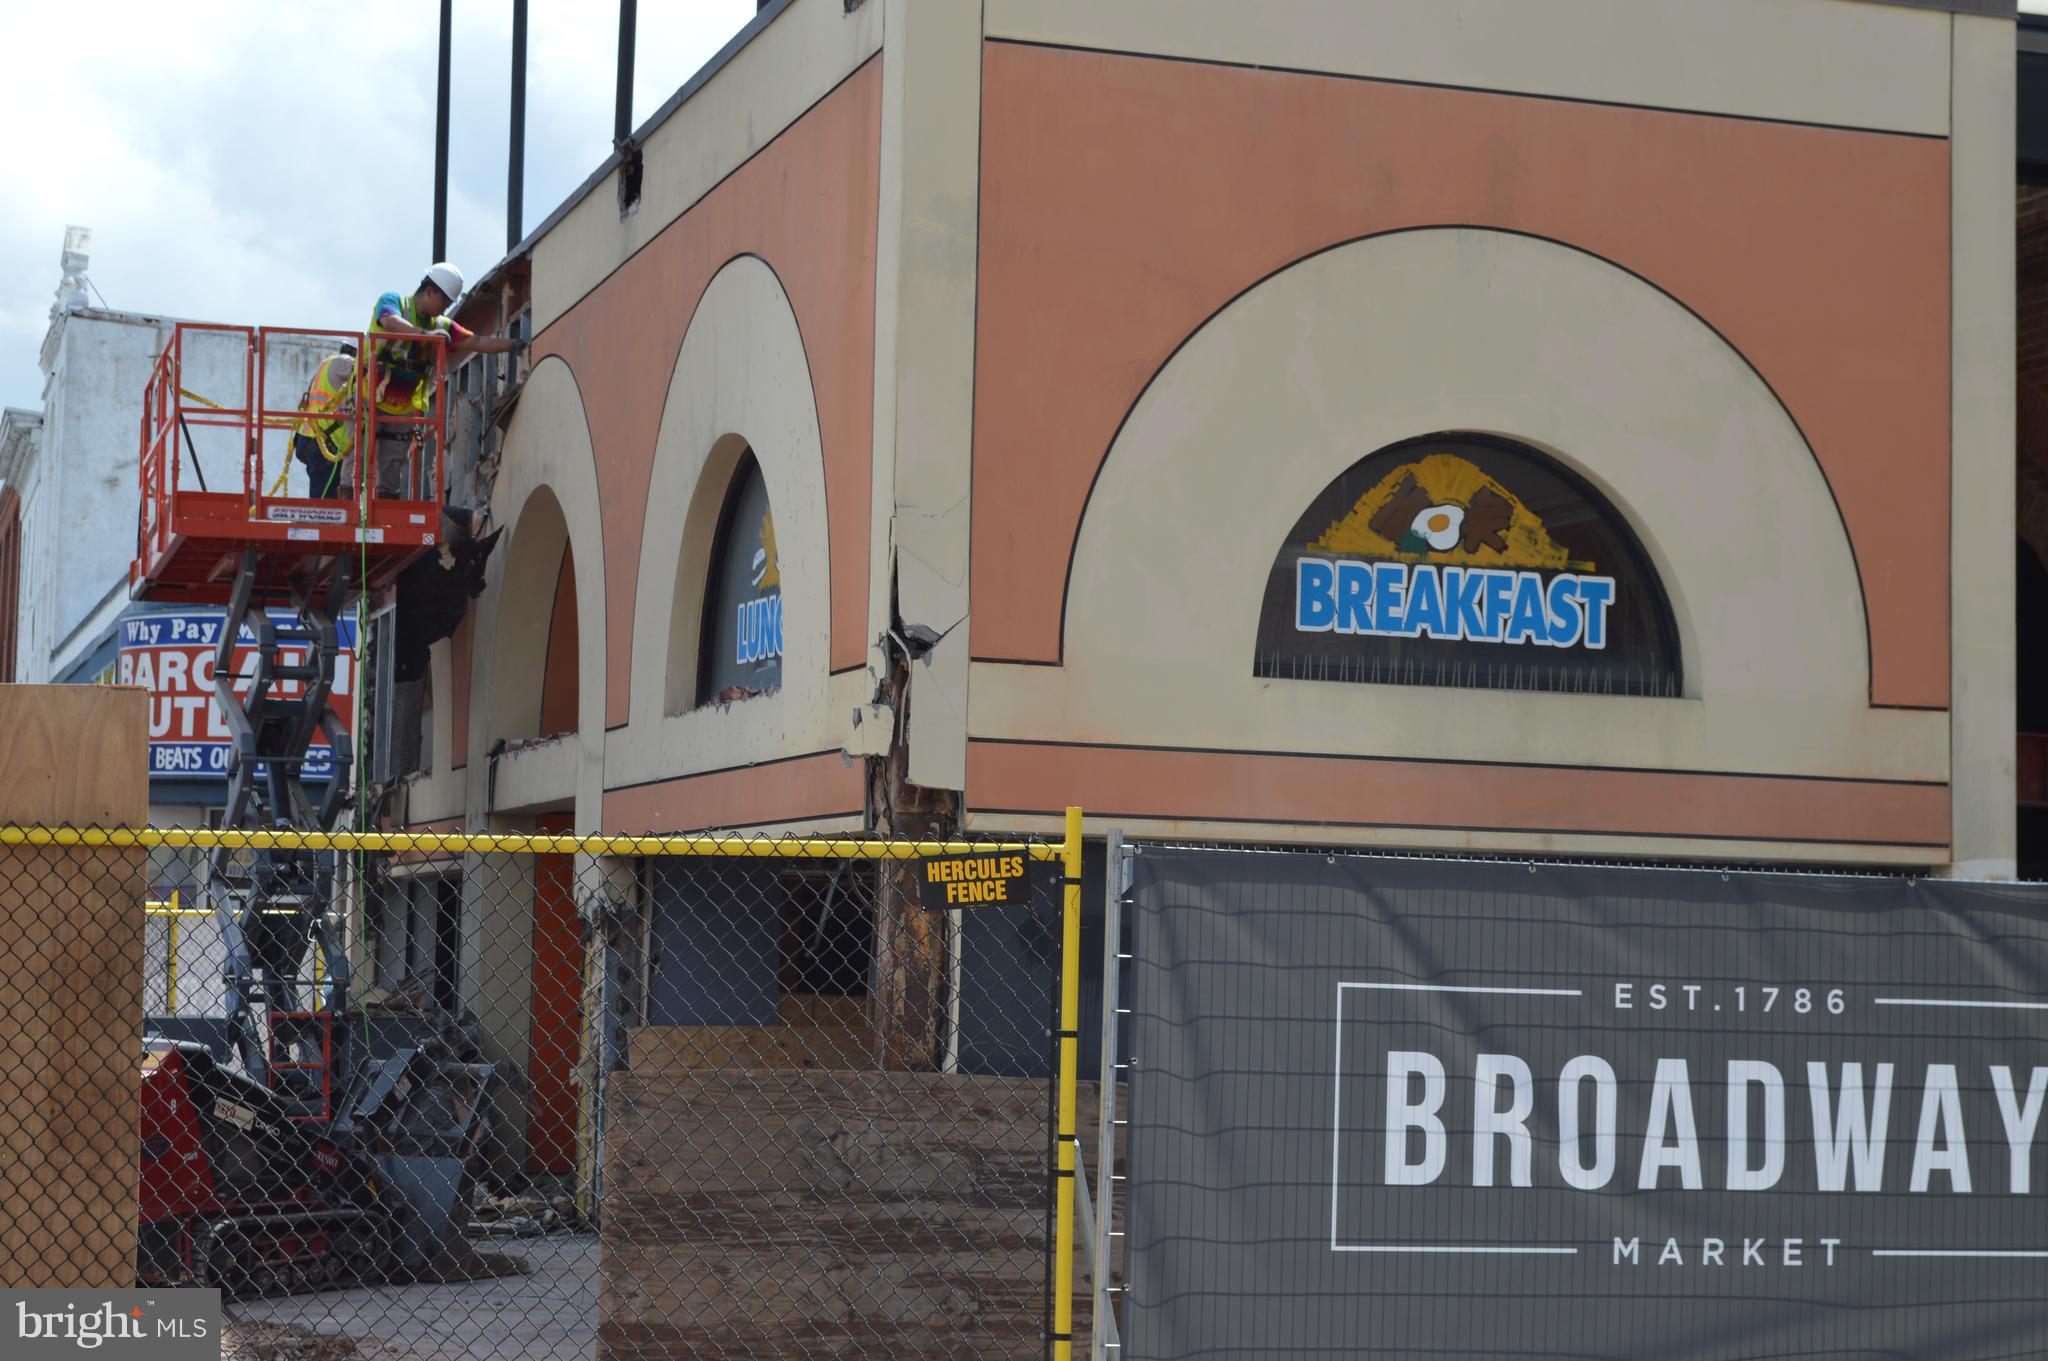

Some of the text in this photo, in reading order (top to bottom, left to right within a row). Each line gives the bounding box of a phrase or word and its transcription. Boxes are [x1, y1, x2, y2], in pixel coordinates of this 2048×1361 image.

[1296, 557, 1616, 650] BREAKFAST
[127, 621, 162, 645] Why
[171, 618, 218, 644] Pay
[736, 594, 784, 665] LUNC
[155, 746, 203, 771] BEATS
[927, 856, 1025, 883] HERCULES
[946, 880, 1008, 904] FENCE
[1614, 983, 1847, 1014] EST.1786
[1384, 1051, 2048, 1194] BROADWAY
[1612, 1237, 1843, 1267] MARKET
